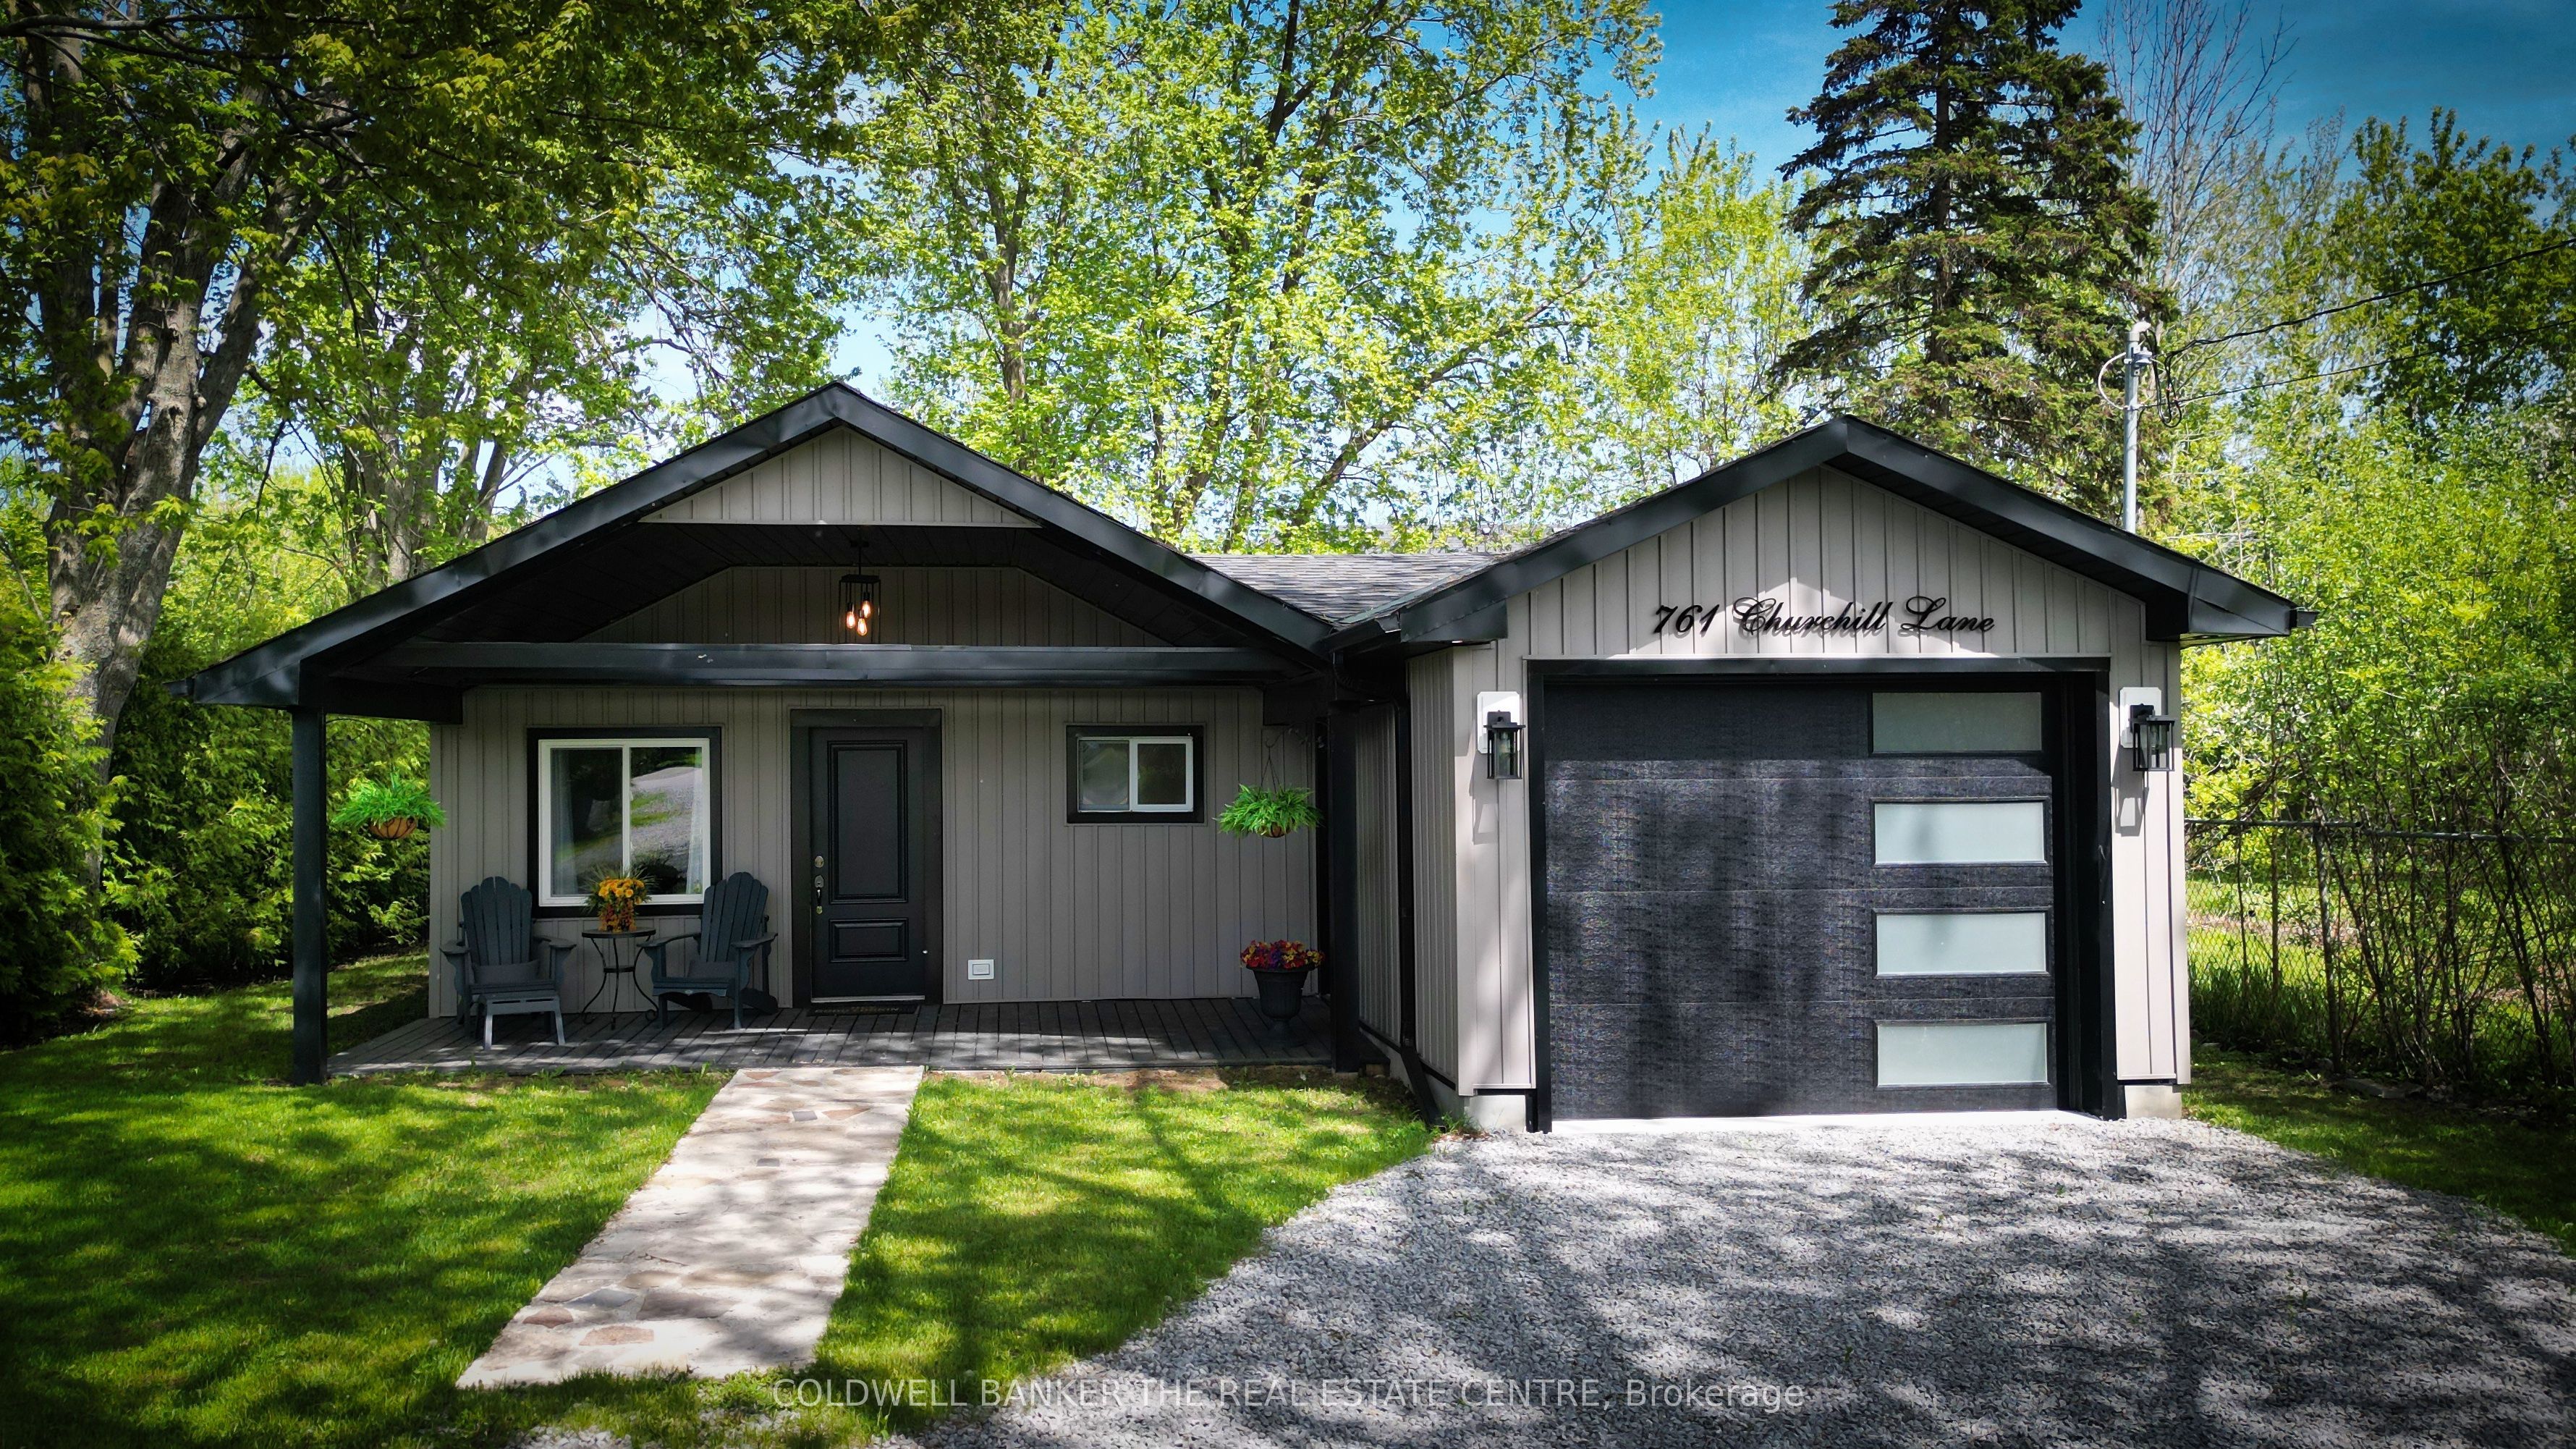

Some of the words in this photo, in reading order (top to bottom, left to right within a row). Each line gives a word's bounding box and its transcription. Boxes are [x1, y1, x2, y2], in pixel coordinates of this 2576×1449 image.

[1654, 604, 1718, 634] 761
[1733, 596, 1894, 635] Churchill
[1900, 595, 1995, 633] Lane
